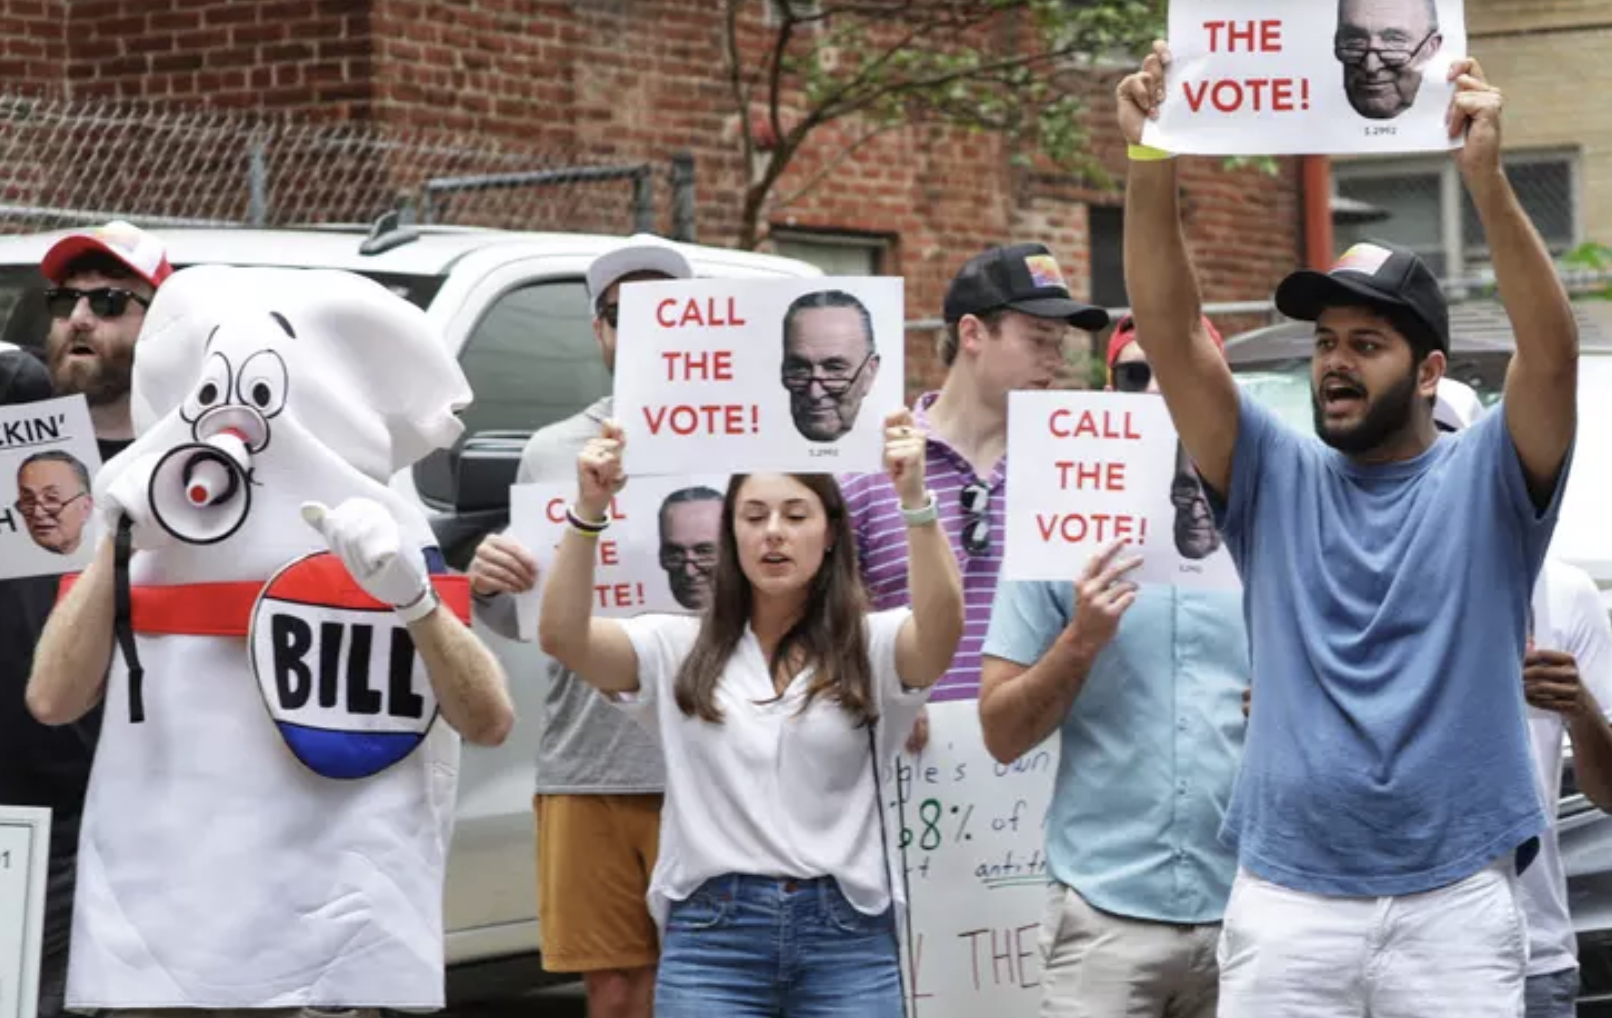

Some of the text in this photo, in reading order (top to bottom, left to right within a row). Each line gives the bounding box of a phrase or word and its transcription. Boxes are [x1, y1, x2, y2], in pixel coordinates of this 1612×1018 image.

[1203, 19, 1282, 53] THE
[1182, 77, 1310, 113] VOTE!
[655, 298, 746, 329] CALL
[662, 350, 734, 382] THE
[0, 413, 65, 444] KIN'
[643, 404, 760, 436] VOTE!
[1049, 408, 1142, 440] CALL
[1055, 460, 1126, 491] THE
[546, 497, 626, 523] CL
[1036, 512, 1147, 545] VOTE!
[594, 582, 645, 608] TE!
[271, 613, 425, 719] BILL
[991, 799, 1027, 831] of
[957, 922, 1042, 991] THE
